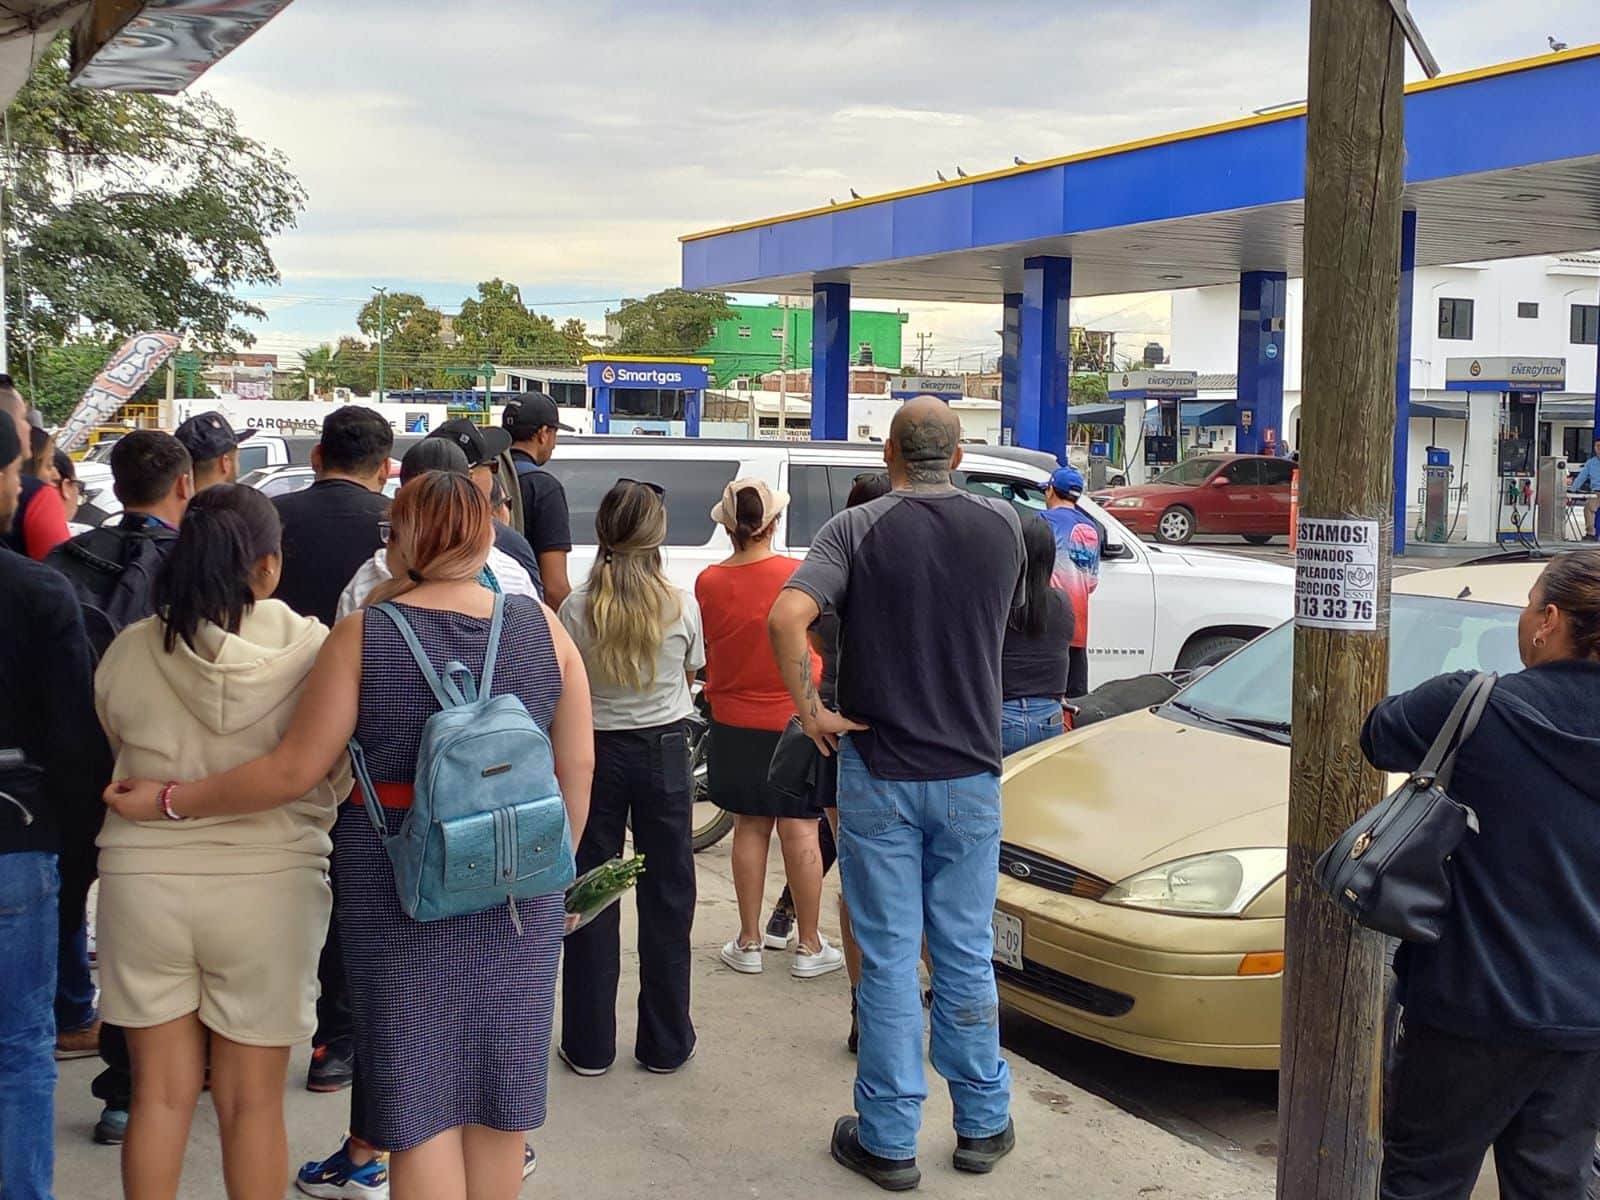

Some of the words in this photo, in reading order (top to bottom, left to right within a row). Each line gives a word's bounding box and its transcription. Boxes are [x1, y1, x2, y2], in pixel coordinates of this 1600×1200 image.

[618, 369, 682, 385] Smartgas
[1323, 599, 1347, 619] 33
[1352, 600, 1372, 620] 76
